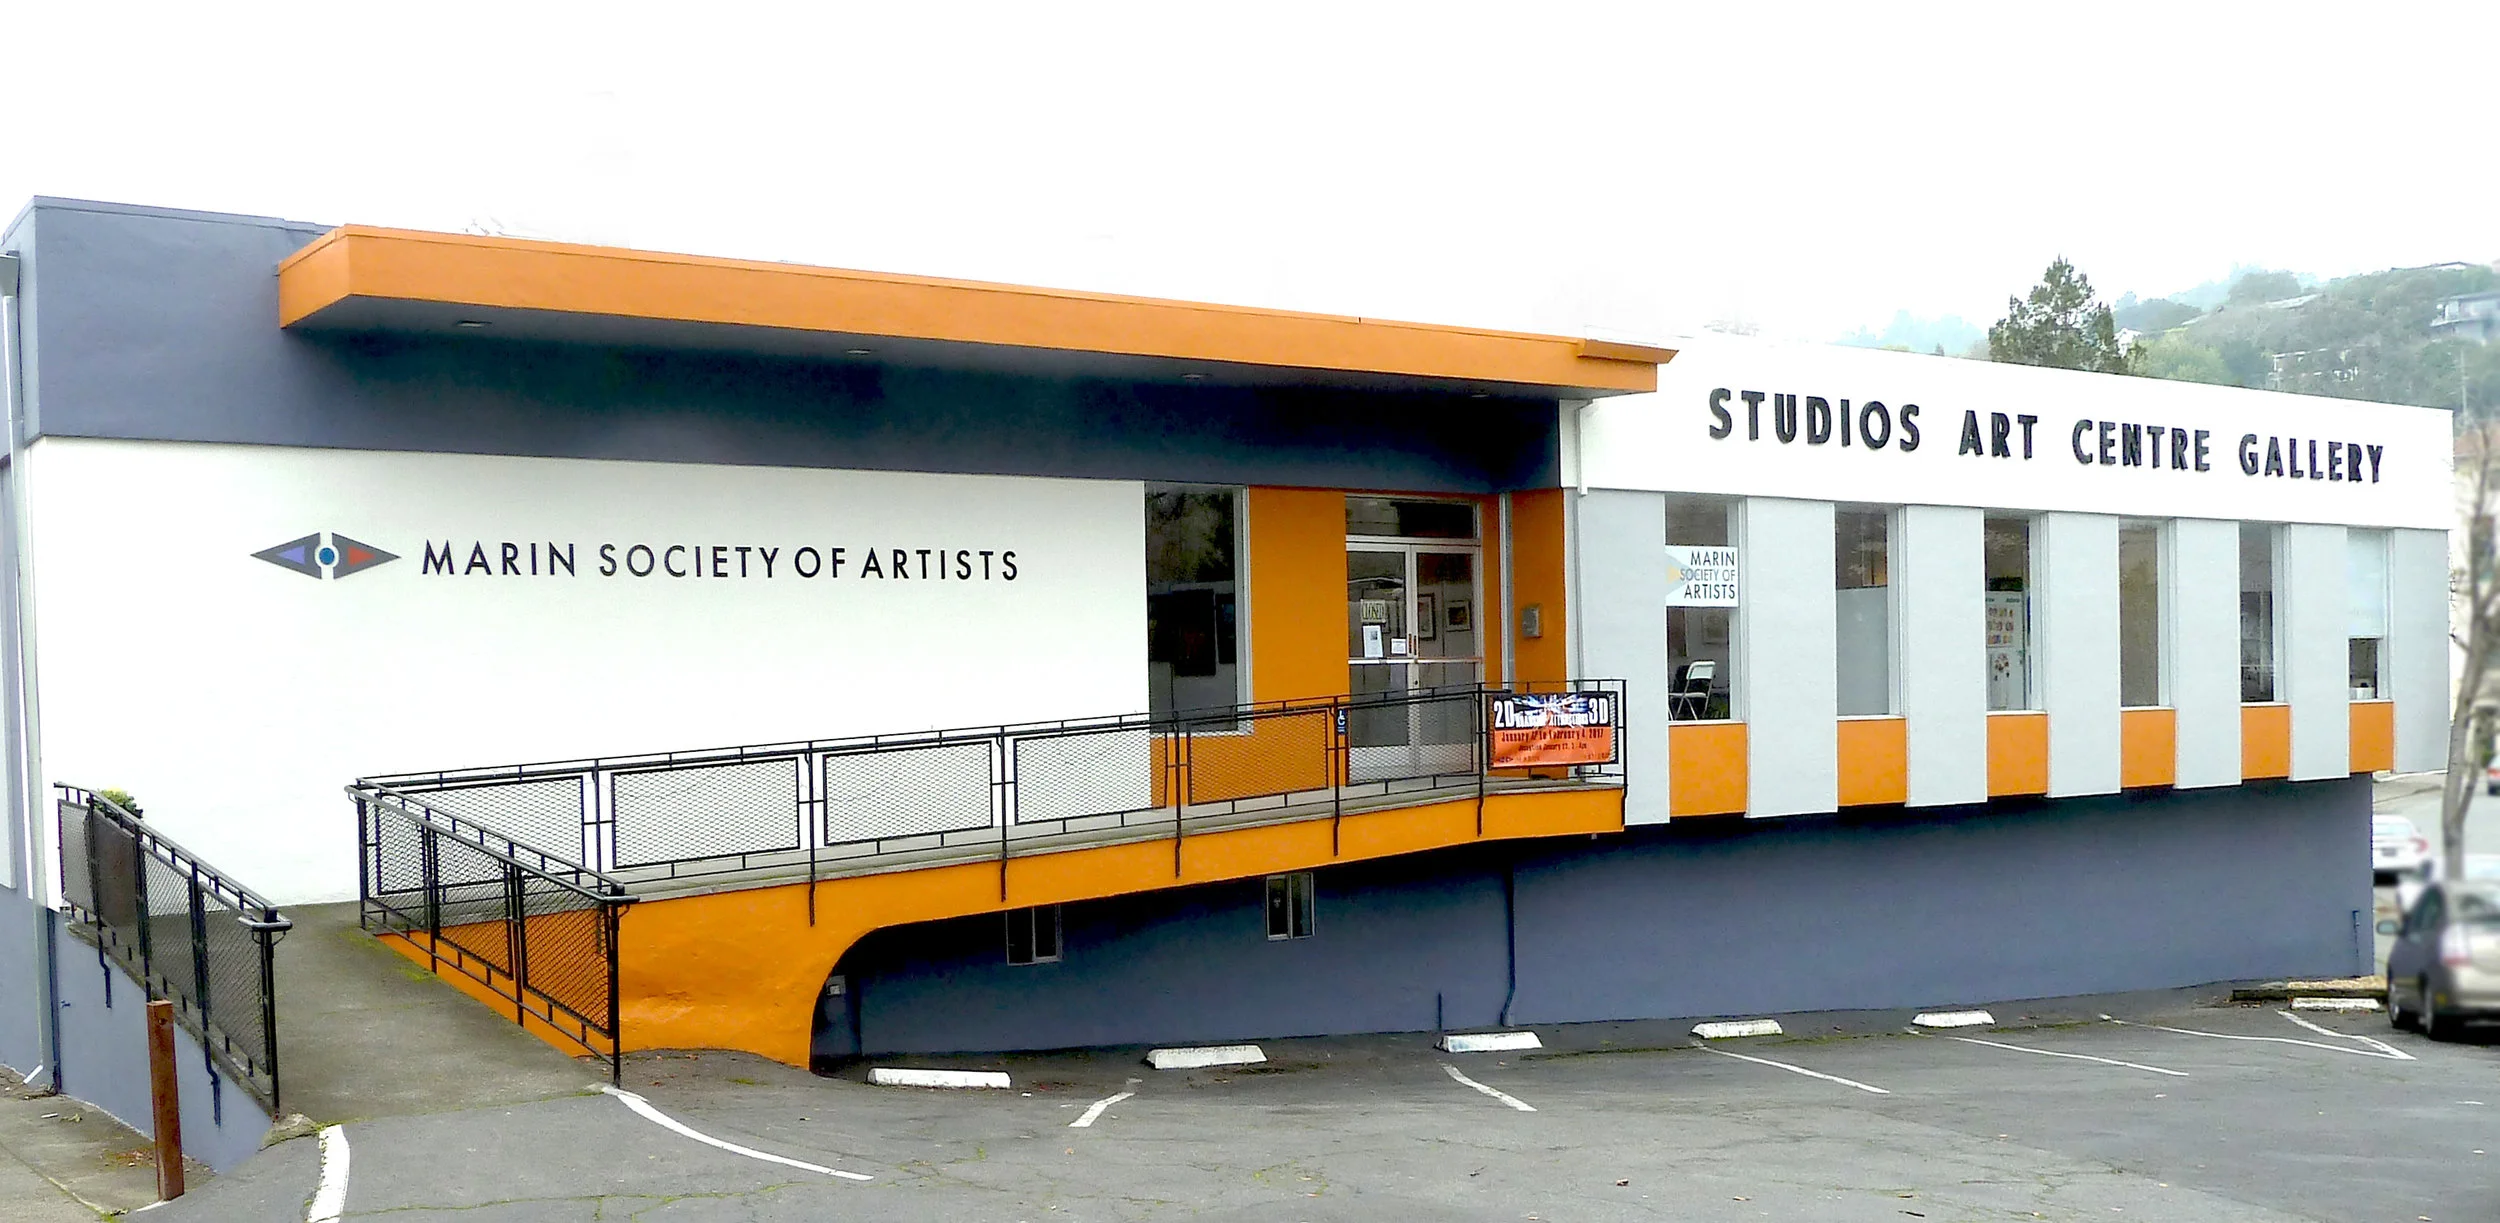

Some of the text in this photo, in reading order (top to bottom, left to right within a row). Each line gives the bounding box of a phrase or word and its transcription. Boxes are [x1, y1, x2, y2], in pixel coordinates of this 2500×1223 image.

[1709, 387, 2385, 485] STUDIOS ART CENTRE GALLERY
[422, 539, 1019, 581] MARIN SOCIETY OF ARTISTS
[1690, 550, 1735, 567] MARIN
[1679, 568, 1736, 582] SOCIETY OF
[1683, 583, 1736, 600] ARTISTS
[1493, 700, 1516, 729] 2D
[1588, 697, 1609, 725] 3D
[1501, 731, 1529, 743] January
[1588, 727, 1604, 739] 2017
